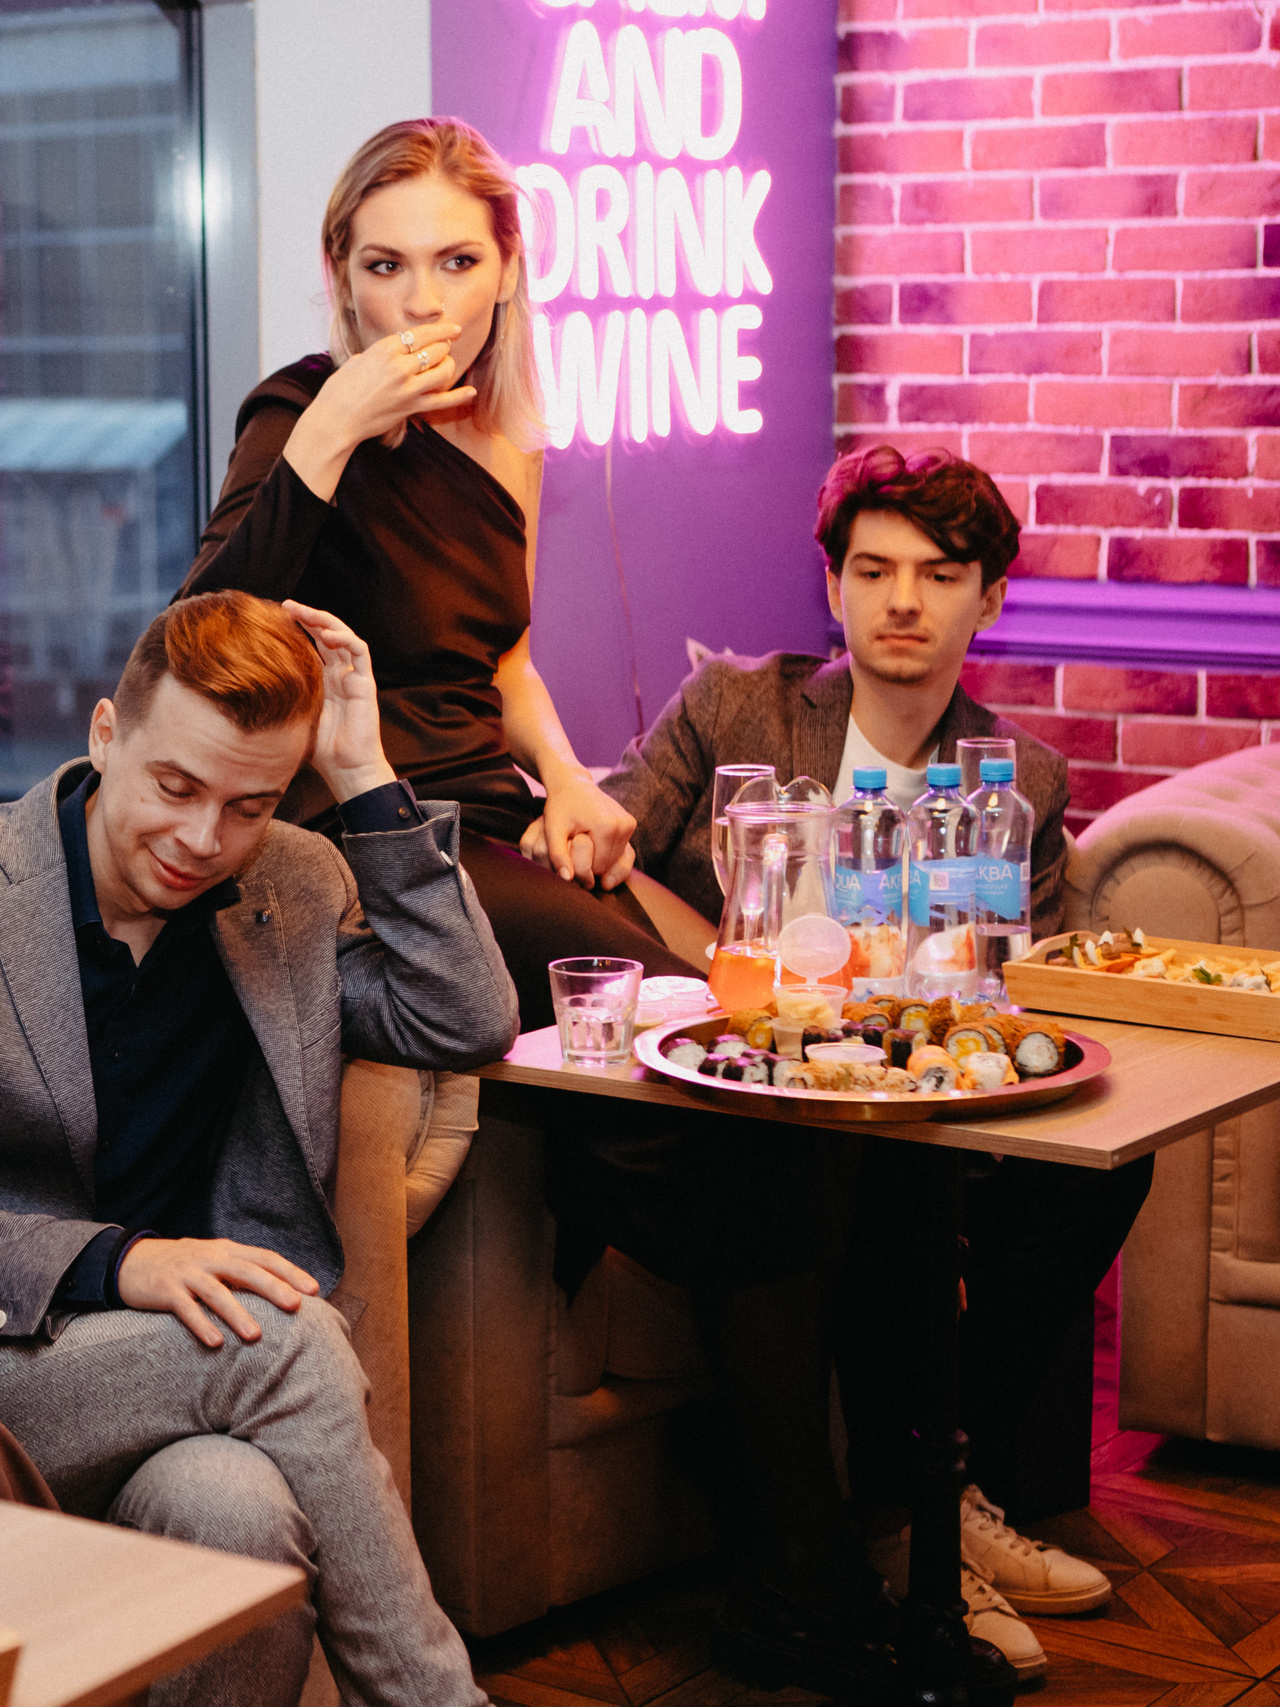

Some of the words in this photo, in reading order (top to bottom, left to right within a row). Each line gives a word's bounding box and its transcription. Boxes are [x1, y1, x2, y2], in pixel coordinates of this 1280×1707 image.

[548, 20, 743, 161] AND
[516, 161, 774, 304] DRINK
[531, 303, 765, 450] WINE
[975, 863, 1014, 883] КВА
